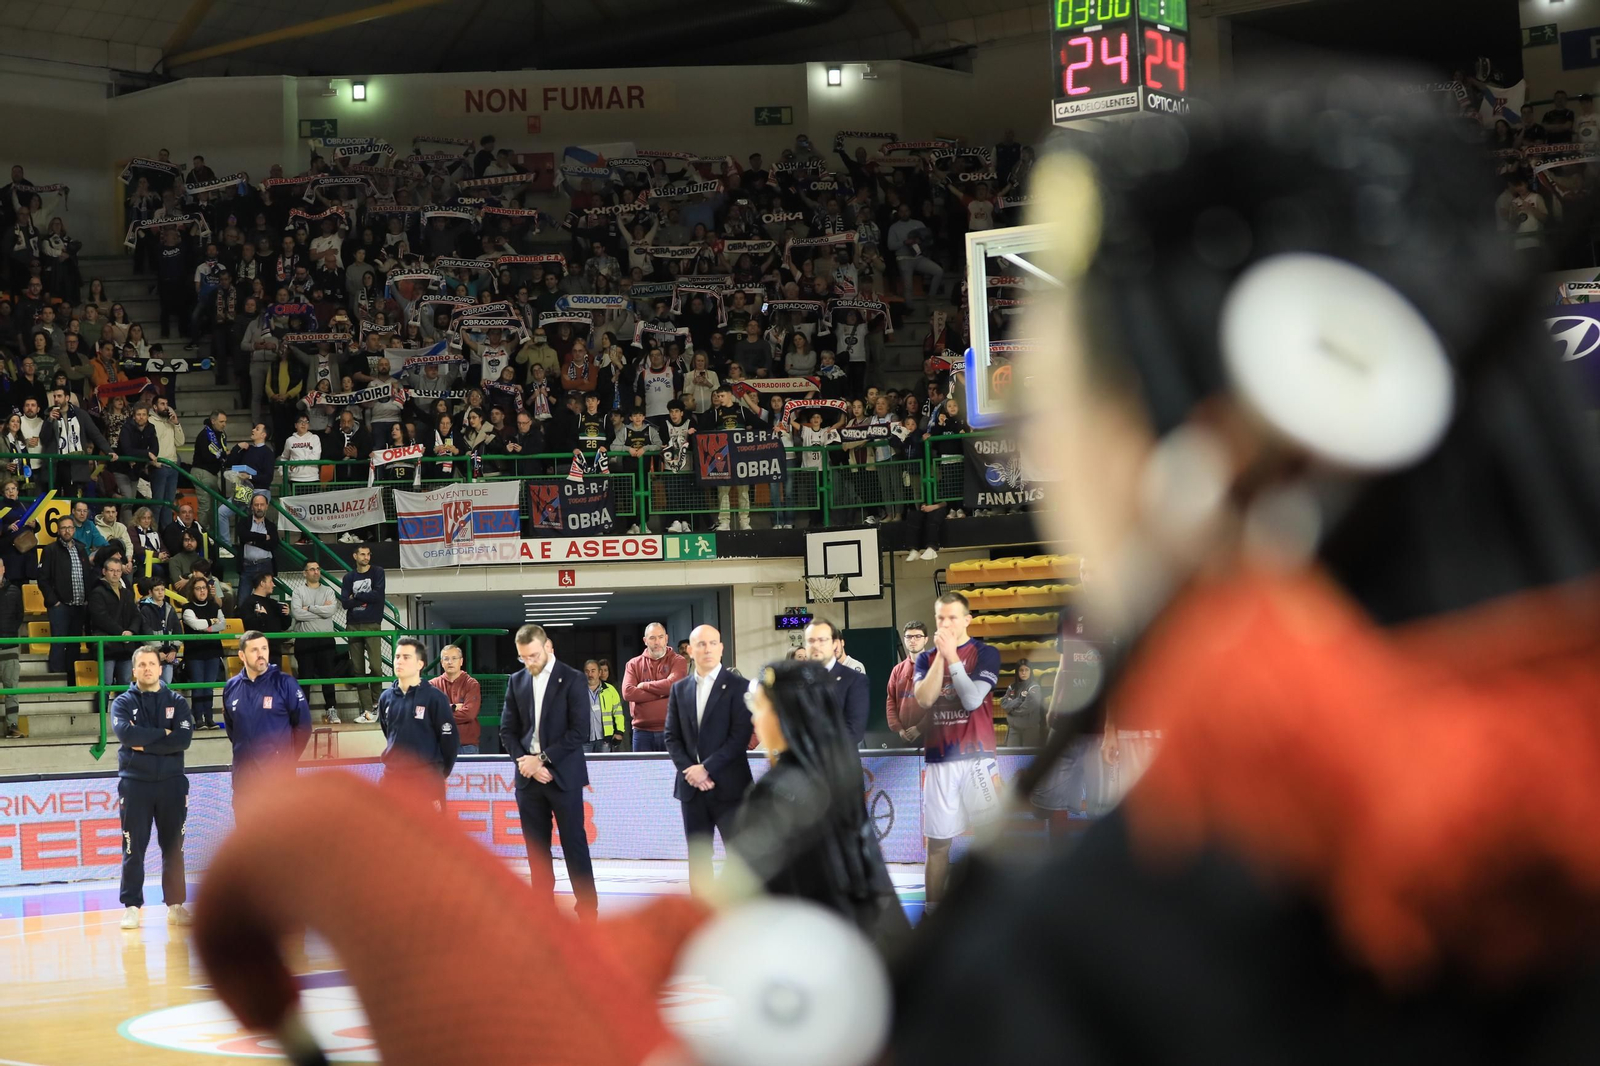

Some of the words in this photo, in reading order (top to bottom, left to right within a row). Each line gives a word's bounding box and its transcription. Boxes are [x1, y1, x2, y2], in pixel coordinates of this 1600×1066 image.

[1064, 32, 1129, 95] 24
[1144, 29, 1186, 92] 24
[465, 88, 527, 113] NON
[543, 85, 645, 111] FUMAR
[1057, 95, 1136, 115] CASADELOSLENTES
[326, 137, 371, 145] OBRADOIRO
[339, 143, 394, 156] OBRADOIRO
[132, 158, 172, 171] OBRADOIRO
[608, 158, 650, 167] OBRADOIRO
[186, 172, 243, 190] OBRADOIRO
[958, 172, 998, 182] OBRA
[654, 182, 717, 197] OBRADOIRO
[810, 181, 838, 191] OBRA
[140, 214, 190, 226] OBRADOIRO
[437, 259, 492, 268] OBRADOIRO
[630, 285, 655, 295] LIVING
[656, 283, 675, 293] MIUD
[421, 294, 475, 304] OBRADOIRO
[571, 296, 624, 304] OBRADOIRO
[836, 300, 883, 309] OBRADOIRO
[274, 303, 307, 315] OBRA
[461, 303, 506, 316] OBRADOIRO
[773, 303, 819, 311] OBRADOIRO
[325, 385, 391, 404] OBRADOIRO
[585, 440, 598, 449] 26
[974, 439, 1016, 455] OBRAD
[383, 444, 421, 461] OBRA
[812, 452, 819, 461] 31
[736, 458, 781, 479] OBRA
[425, 489, 489, 502] XUVENTUDE
[977, 487, 1045, 506] FANATICS
[308, 499, 365, 515] OBRAJAZZ
[567, 507, 613, 530] OBRA
[423, 545, 498, 558] OBRADOIRISTA
[541, 541, 552, 558] E
[565, 538, 659, 558] ASEOS
